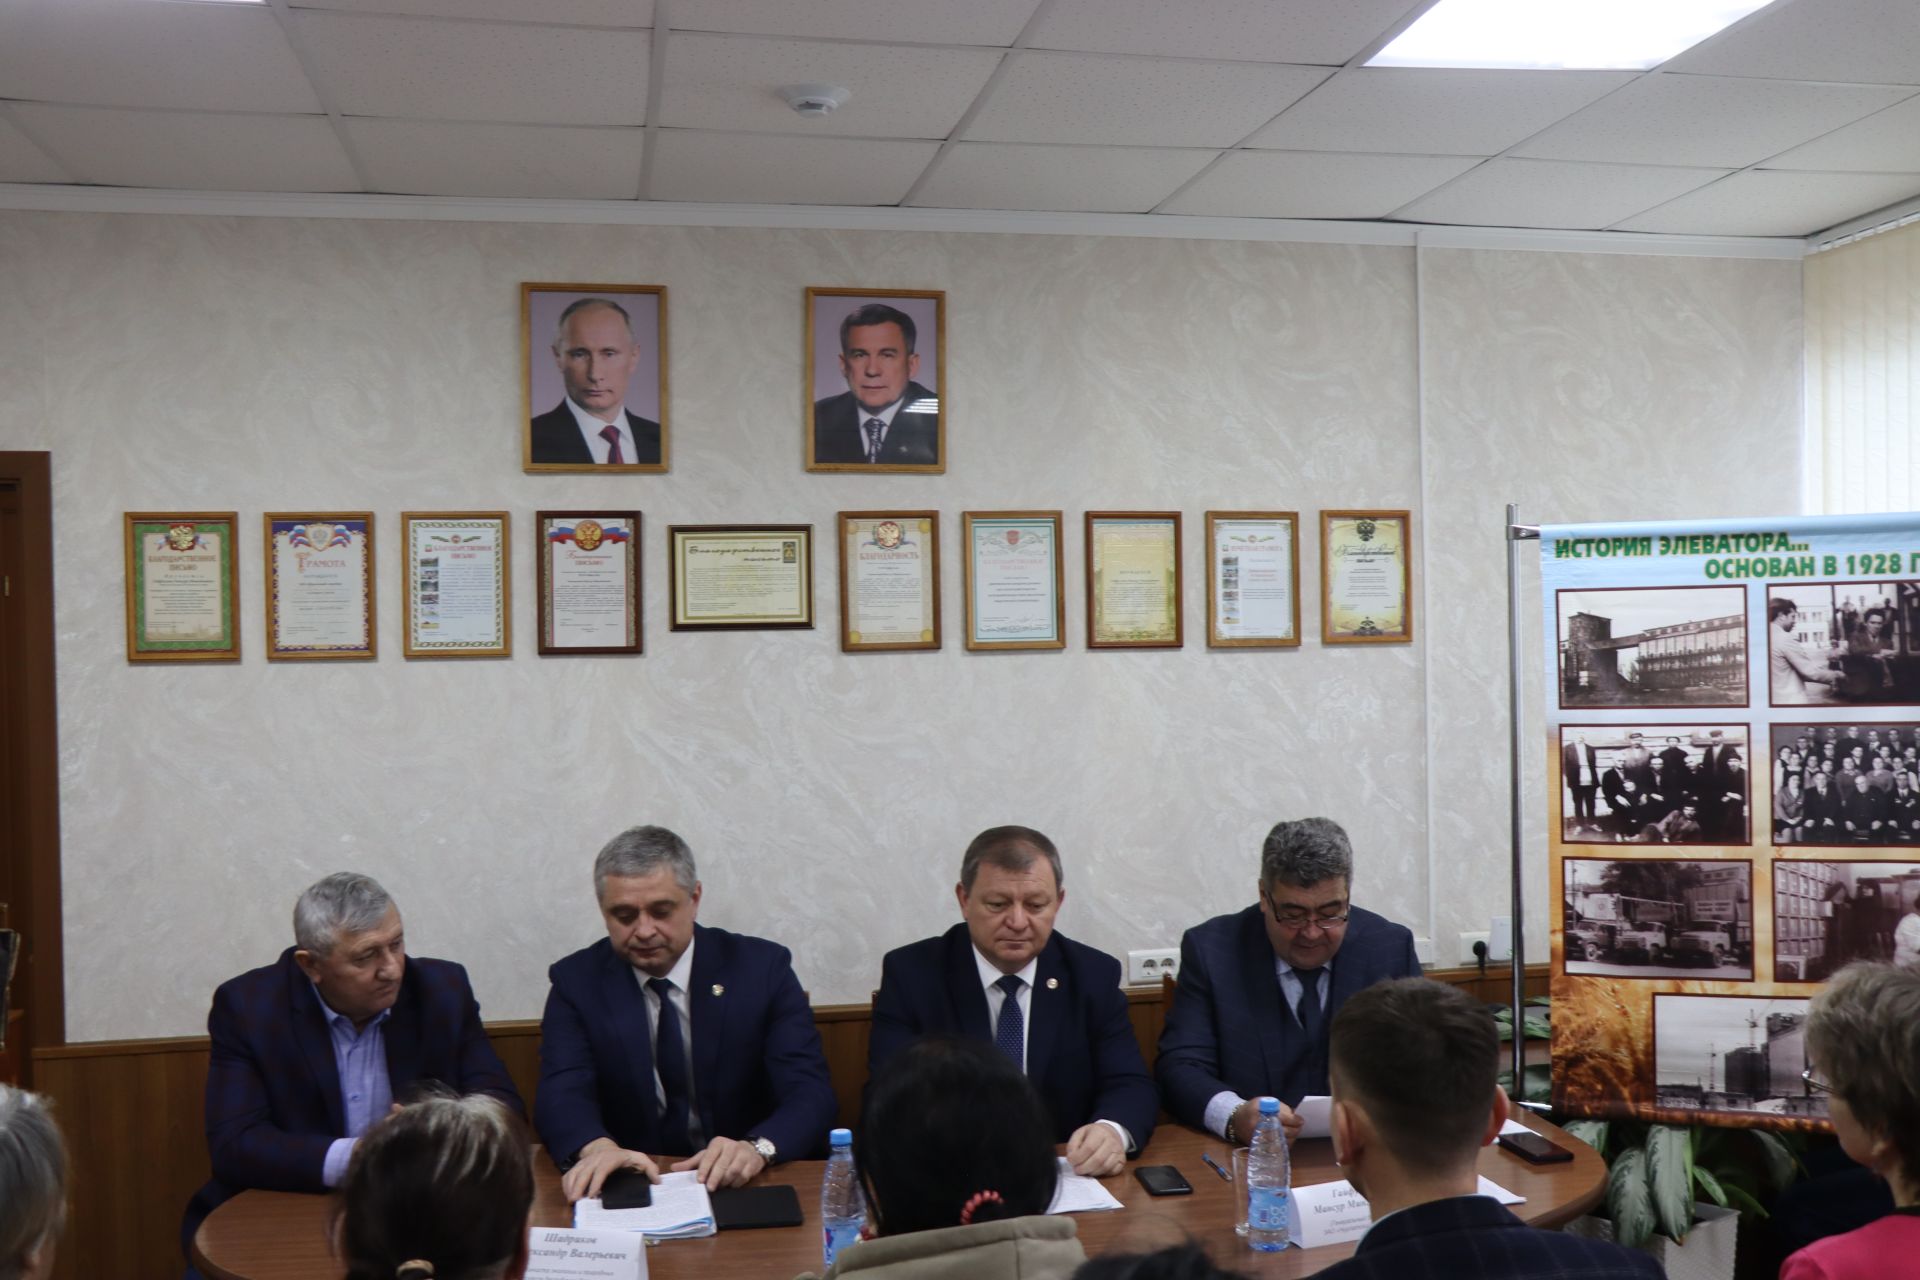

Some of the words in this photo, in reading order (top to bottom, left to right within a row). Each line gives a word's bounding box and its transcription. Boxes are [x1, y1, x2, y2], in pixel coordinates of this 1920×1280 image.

[1554, 537, 1652, 559] ИСТОРИЯ
[1659, 532, 1809, 556] ЭЛЕВАТОРА...
[1705, 556, 1816, 580] ОСНОВАН
[1823, 555, 1838, 577] В
[1846, 553, 1902, 576] 1928
